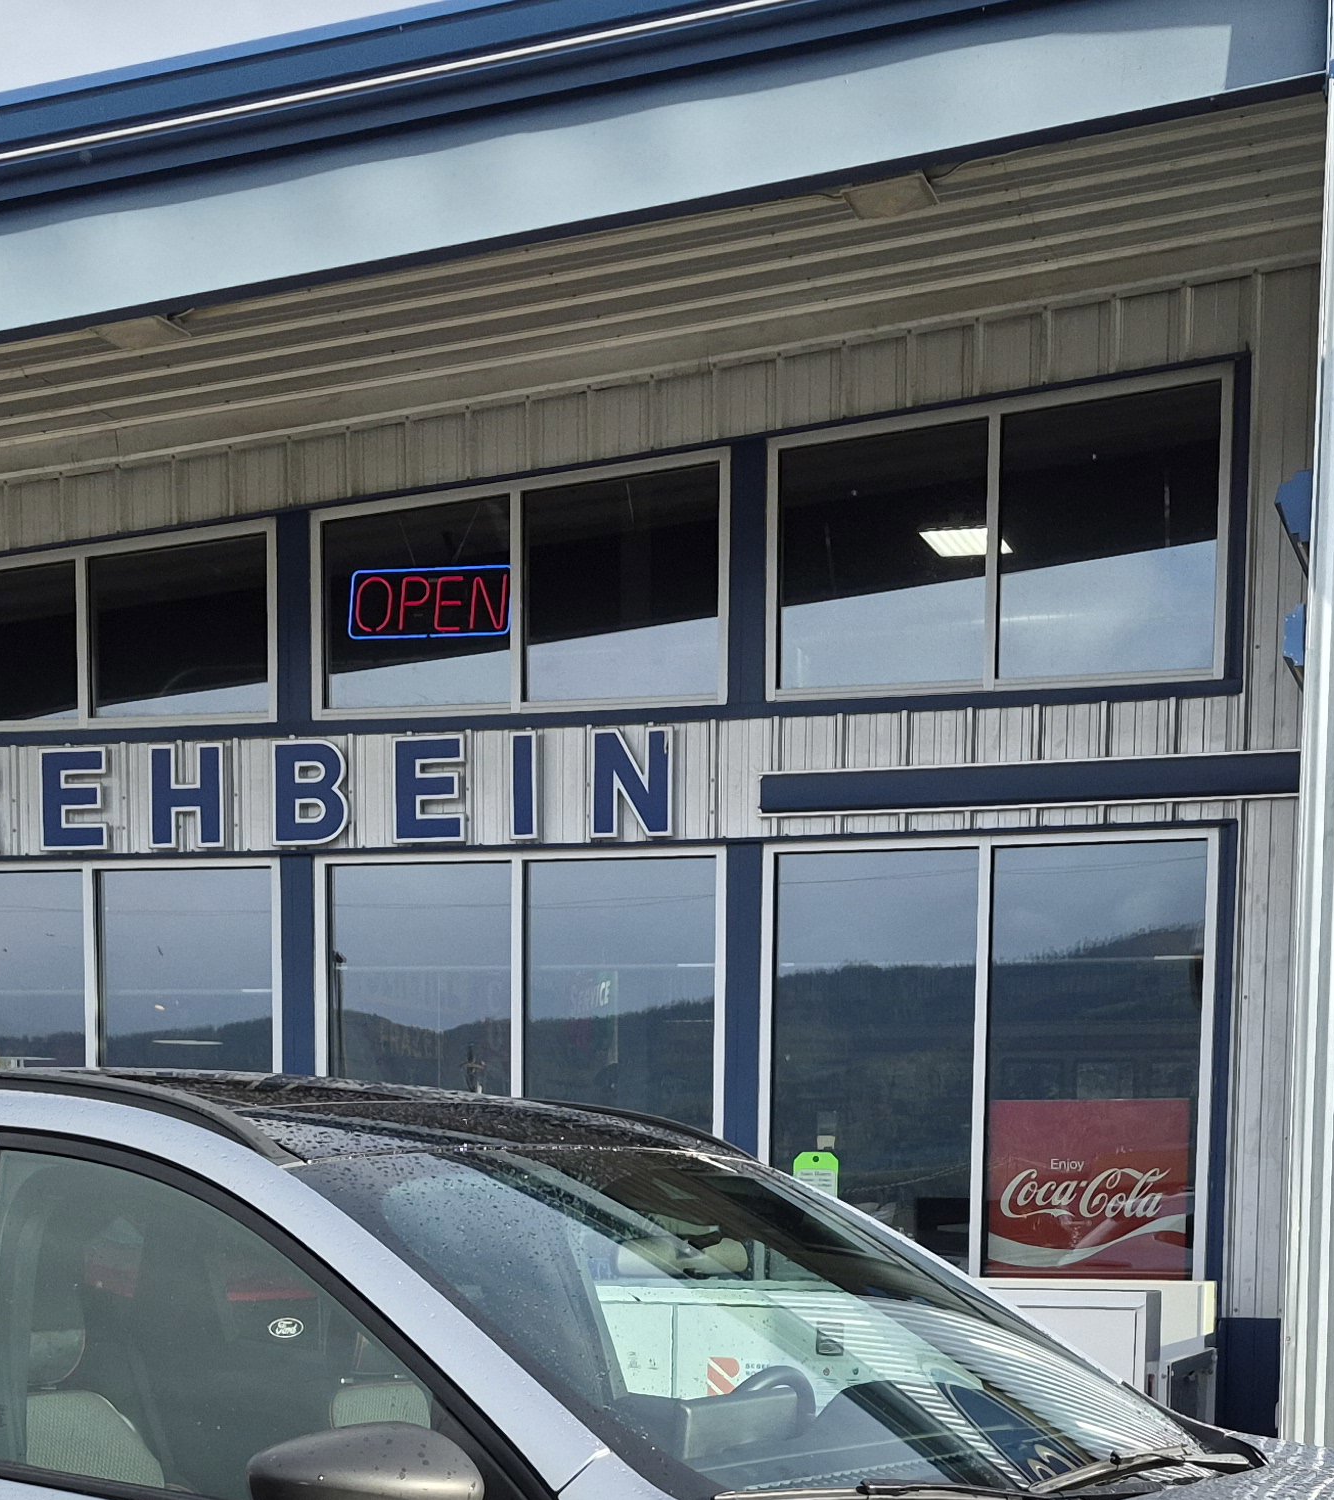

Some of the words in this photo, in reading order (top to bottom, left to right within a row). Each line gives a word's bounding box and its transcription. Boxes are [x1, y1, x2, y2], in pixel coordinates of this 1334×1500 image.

[354, 573, 508, 633] OPEN
[1050, 1158, 1085, 1172] Enjoy
[999, 1167, 1172, 1219] Coca-Cola
[275, 1320, 298, 1335] Ford
